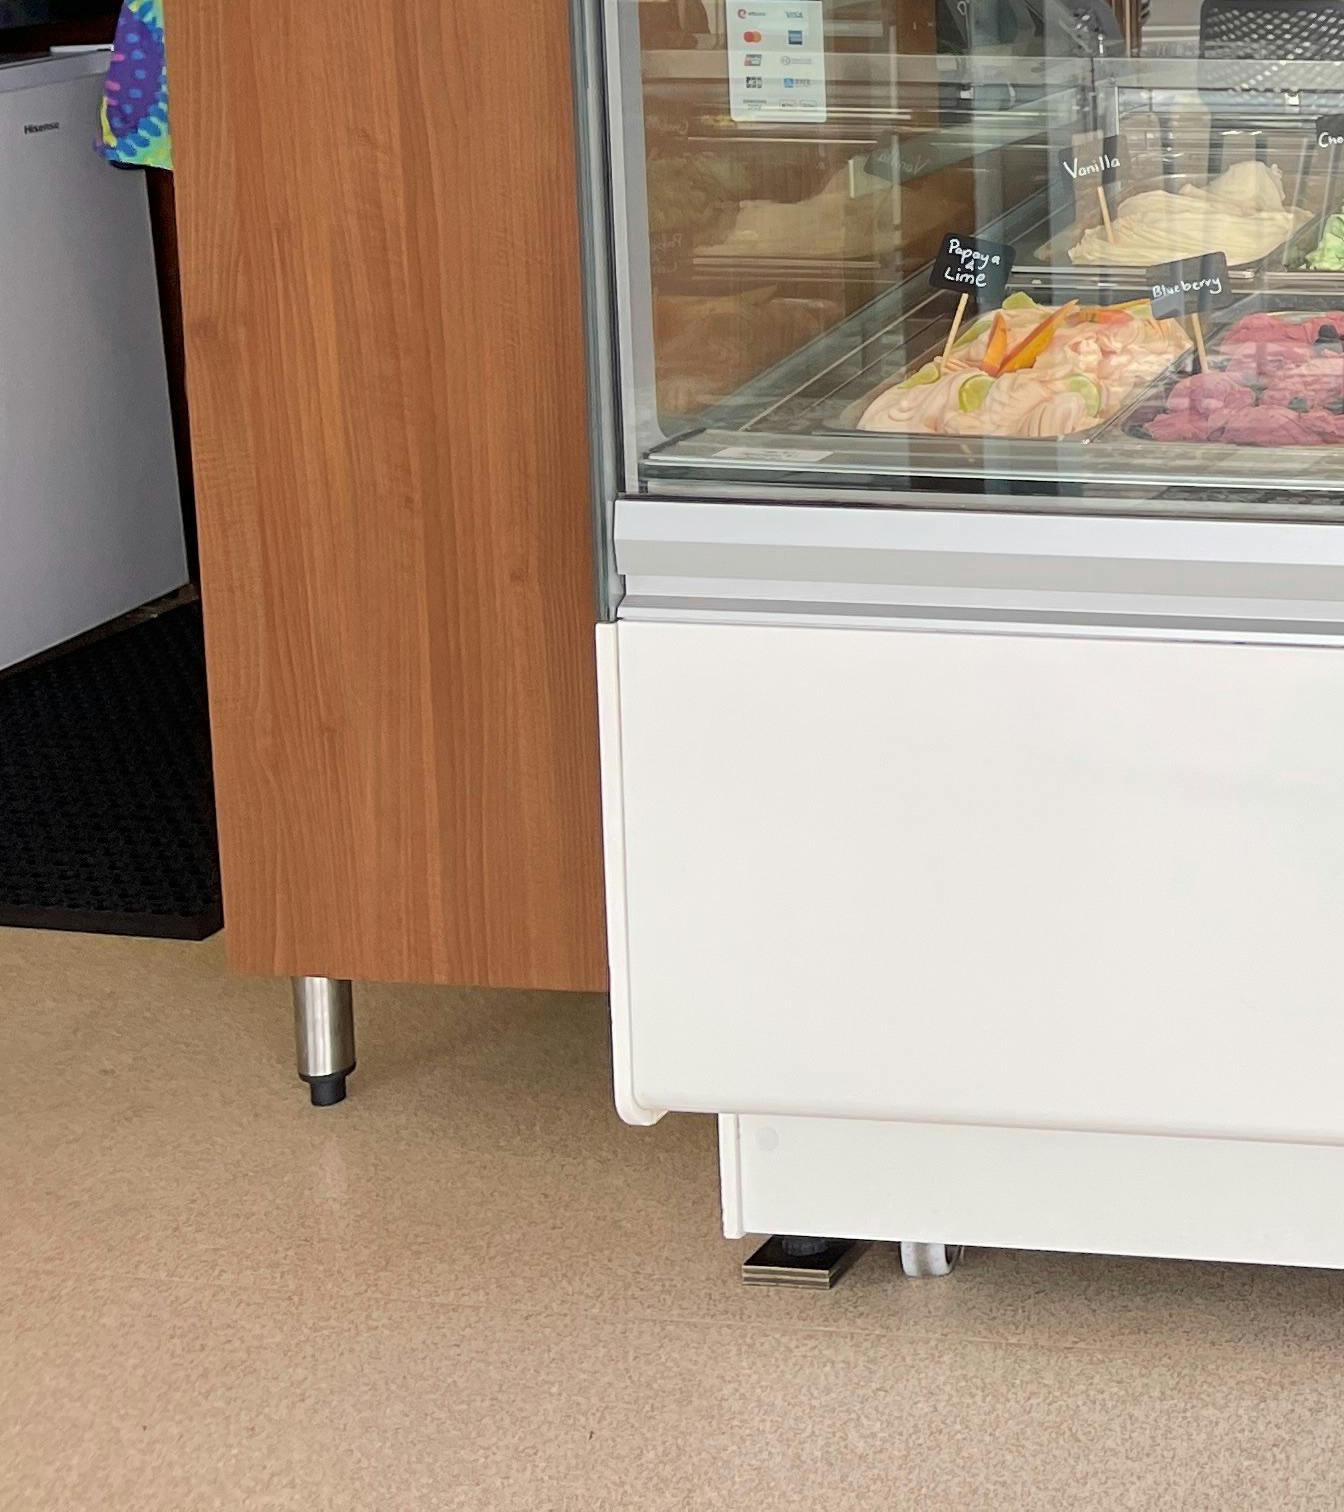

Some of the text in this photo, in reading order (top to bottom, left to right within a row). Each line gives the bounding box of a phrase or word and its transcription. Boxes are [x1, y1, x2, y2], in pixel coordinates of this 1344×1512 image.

[1063, 154, 1120, 180] Vanilla
[949, 238, 1000, 270] Papaya
[944, 267, 987, 287] Lime
[1152, 274, 1222, 300] Blueberry
